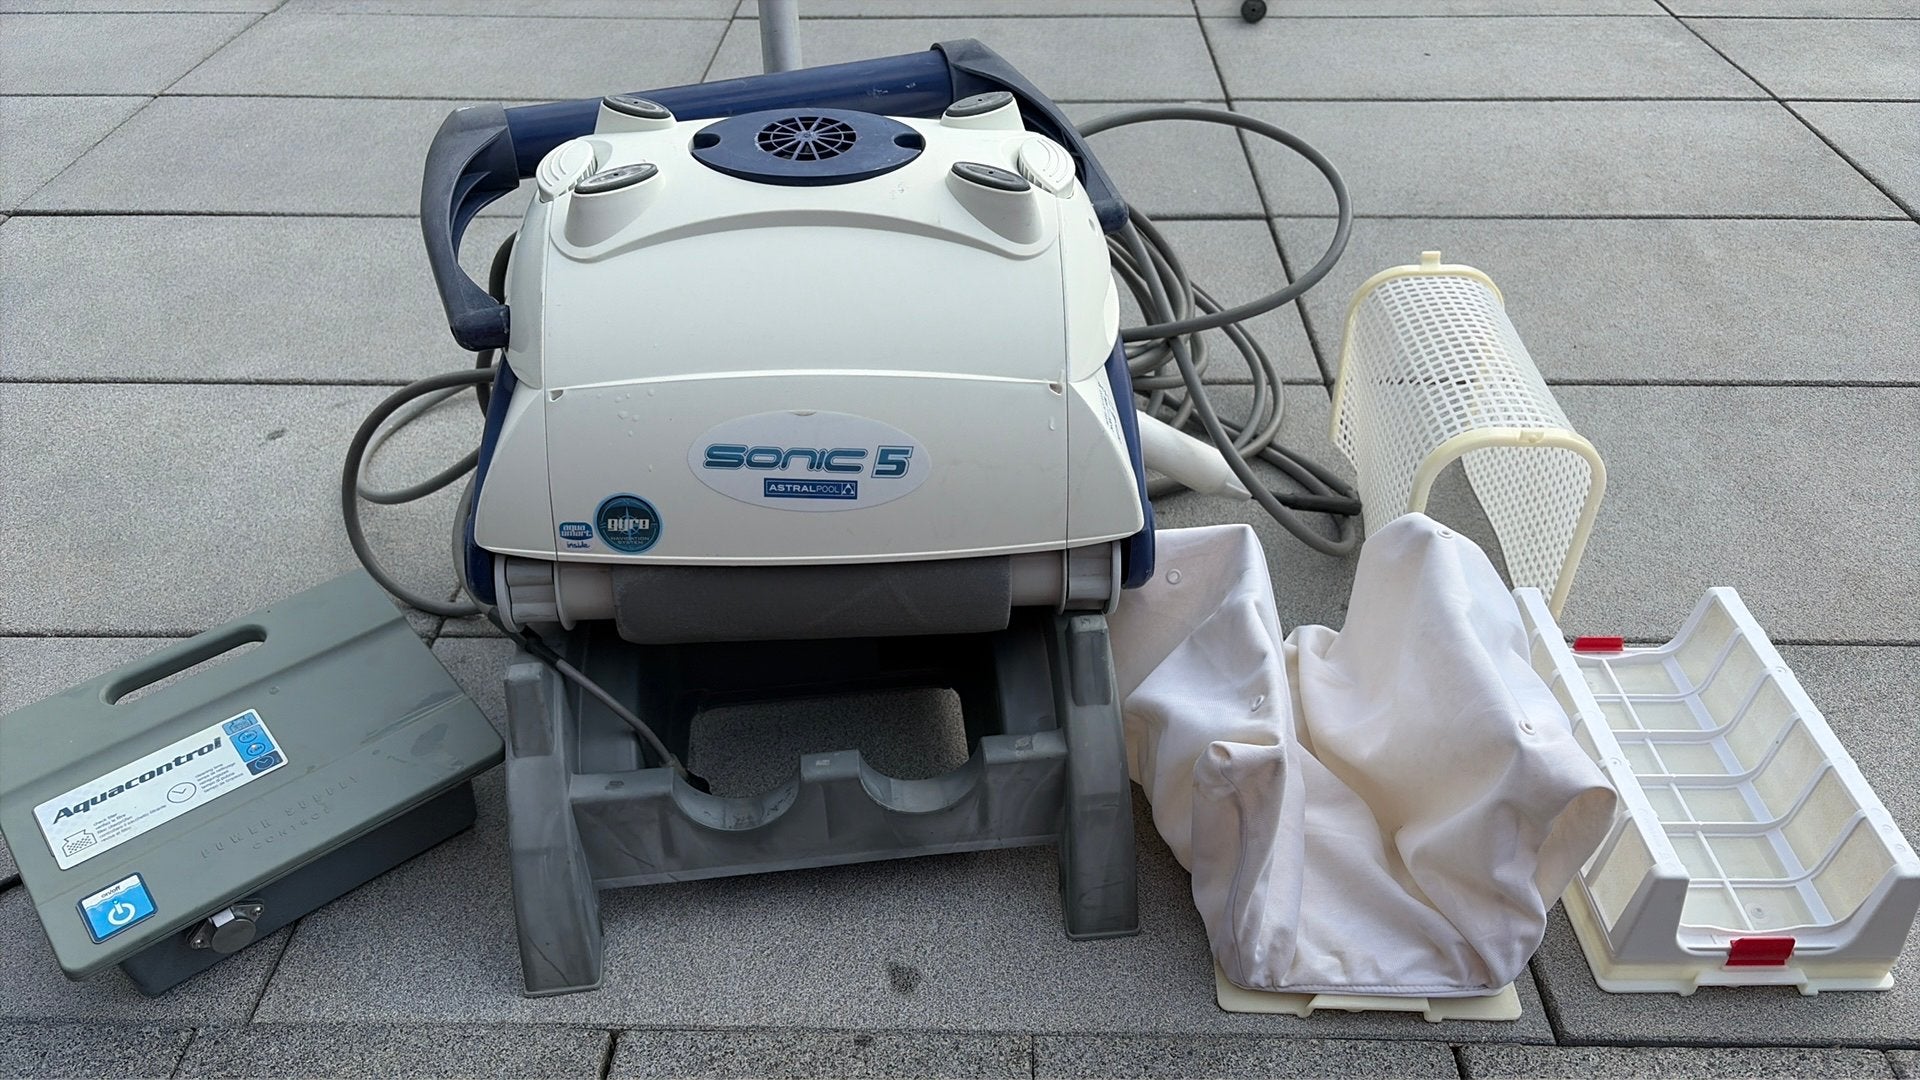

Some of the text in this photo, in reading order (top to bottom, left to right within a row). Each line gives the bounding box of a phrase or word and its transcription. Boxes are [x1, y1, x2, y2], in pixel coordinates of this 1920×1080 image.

[871, 445, 914, 479] 5
[769, 483, 840, 494] ASTRALPOOL
[53, 737, 222, 825] Aquacontrol
[101, 885, 121, 899] on/off
